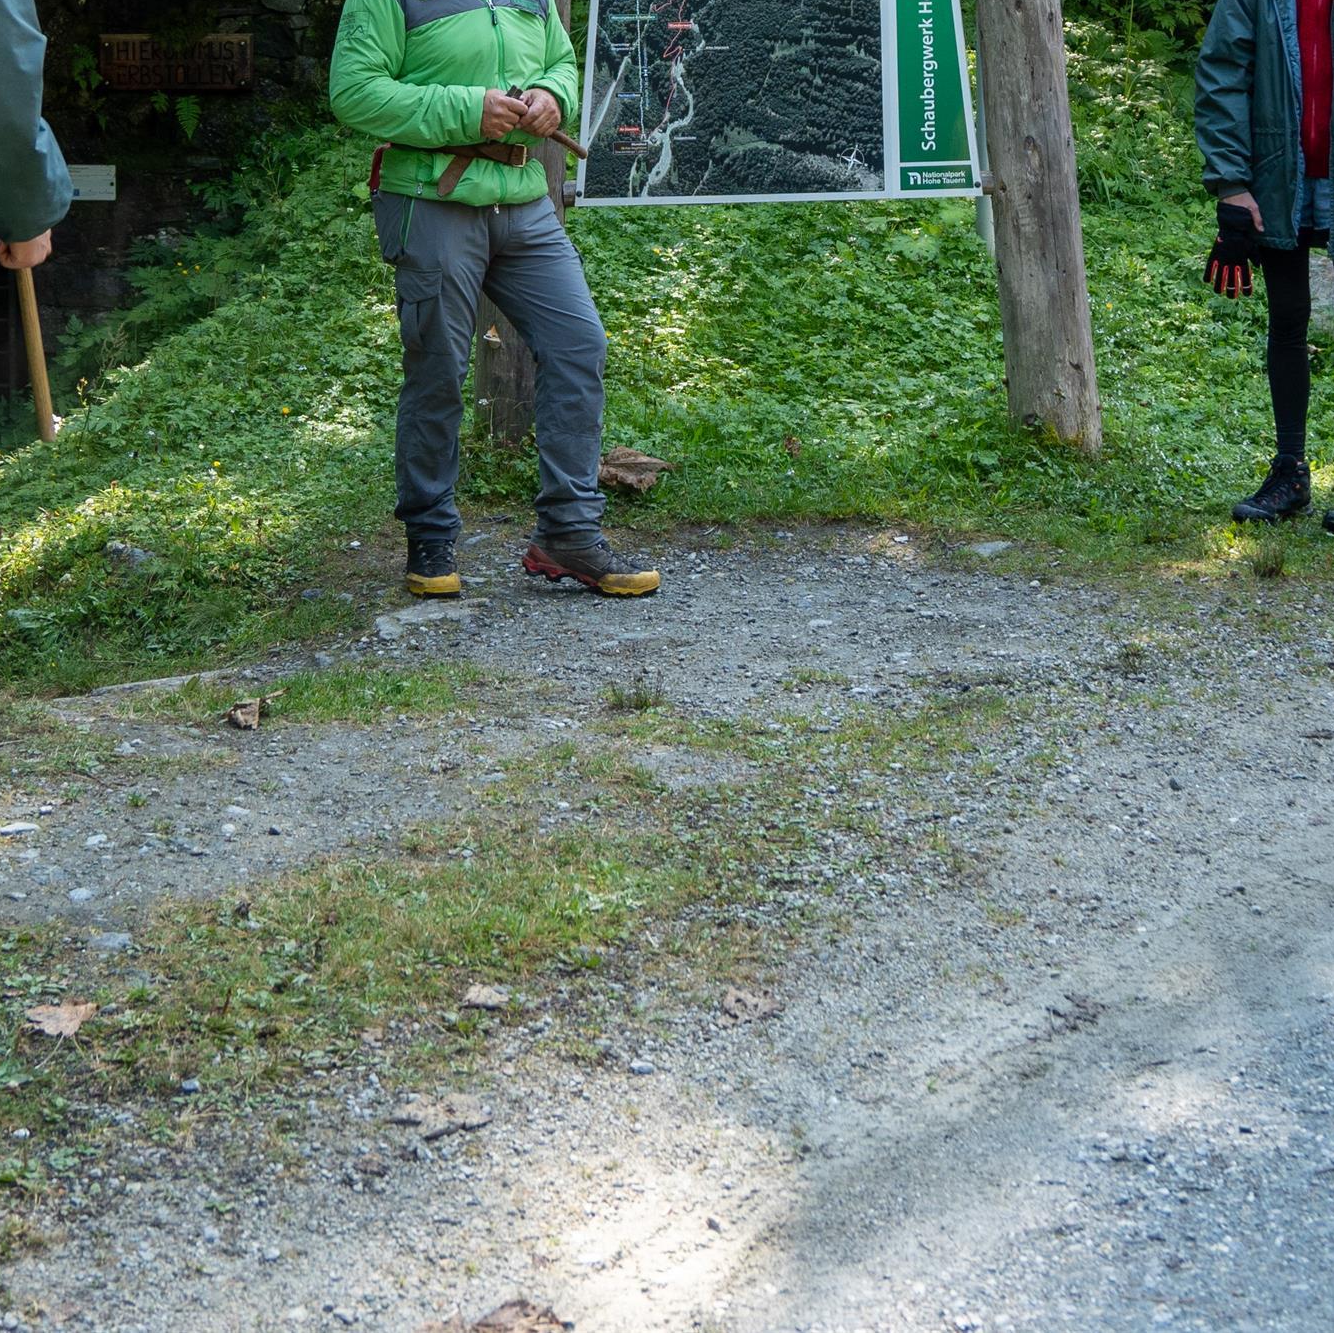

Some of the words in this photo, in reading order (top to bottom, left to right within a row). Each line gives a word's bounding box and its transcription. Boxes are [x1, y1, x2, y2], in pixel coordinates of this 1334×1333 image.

[116, 64, 235, 86] ERBSTOLLEN
[918, 18, 938, 151] Schaubergwerk
[922, 170, 966, 179] Nationalpark
[922, 177, 941, 185] Hohe
